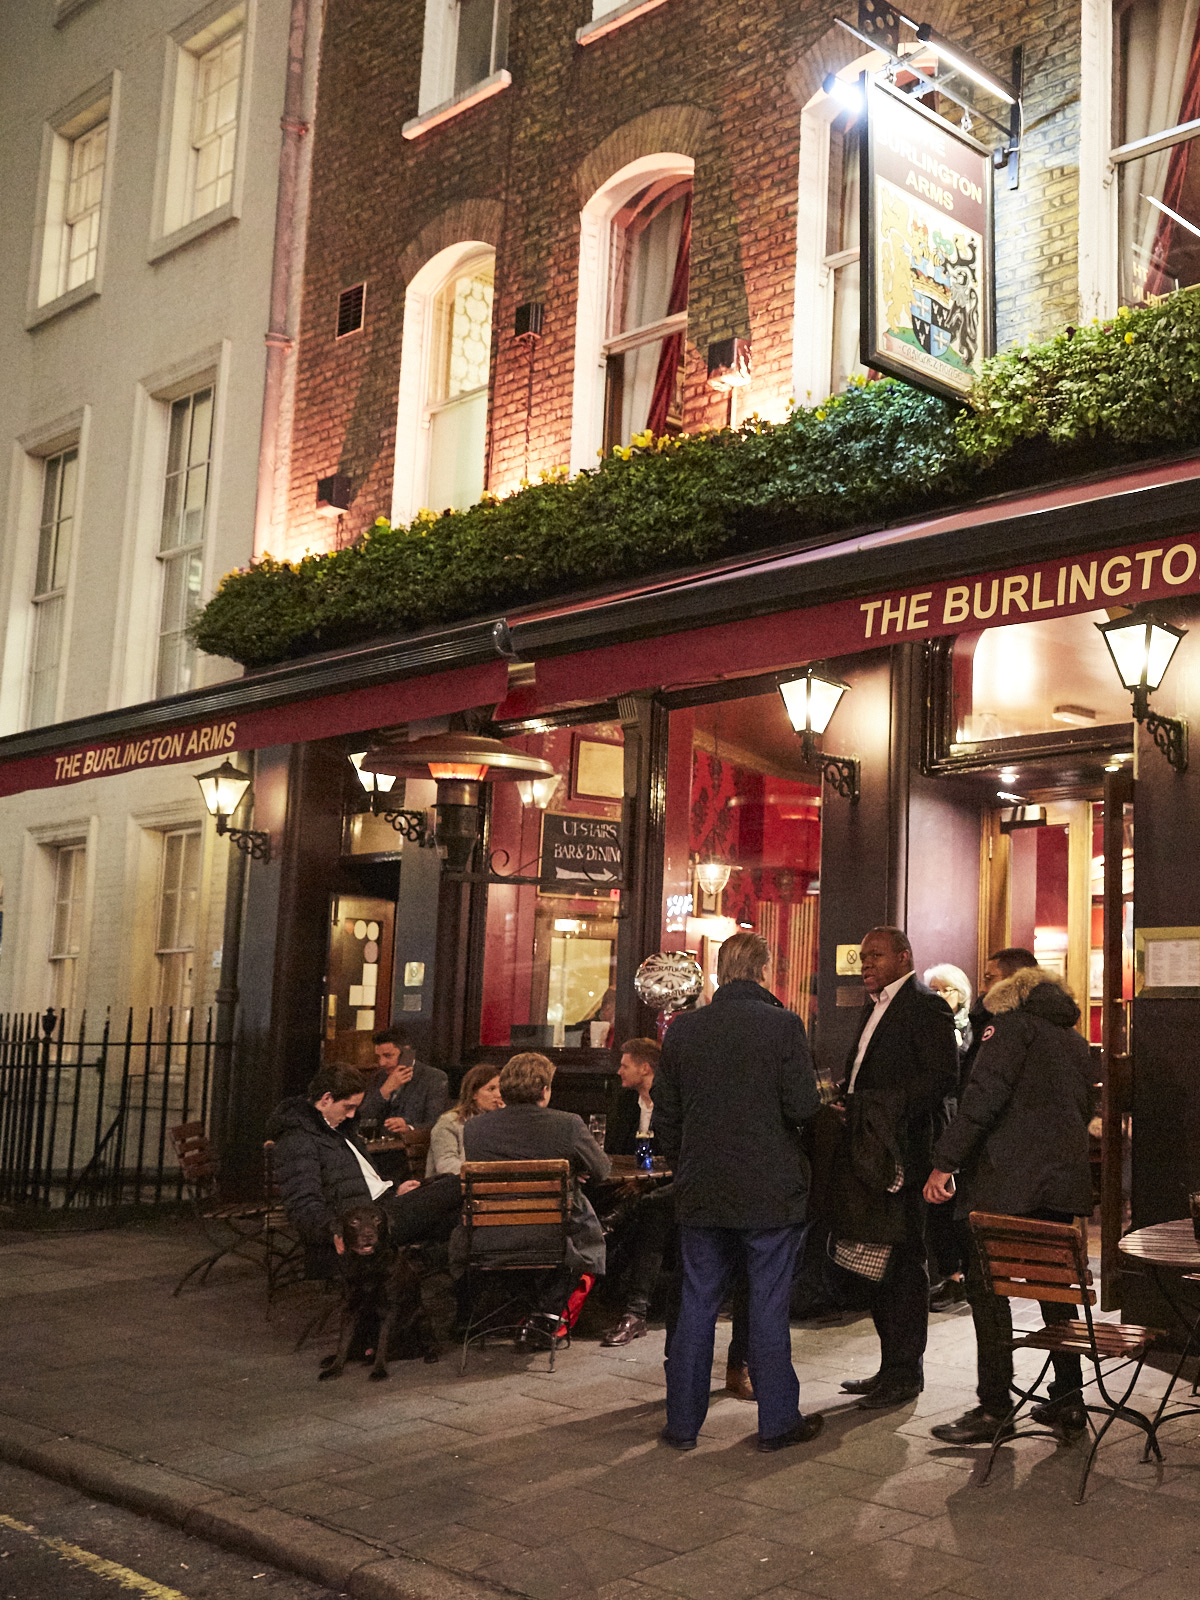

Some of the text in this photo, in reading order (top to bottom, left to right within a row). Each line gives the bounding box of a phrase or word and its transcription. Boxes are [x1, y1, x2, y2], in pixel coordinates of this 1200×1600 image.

[905, 169, 954, 211] ARMS
[859, 591, 932, 638] THE
[54, 721, 237, 780] THE BURLINGTON ARMS
[554, 843, 575, 859] BAR
